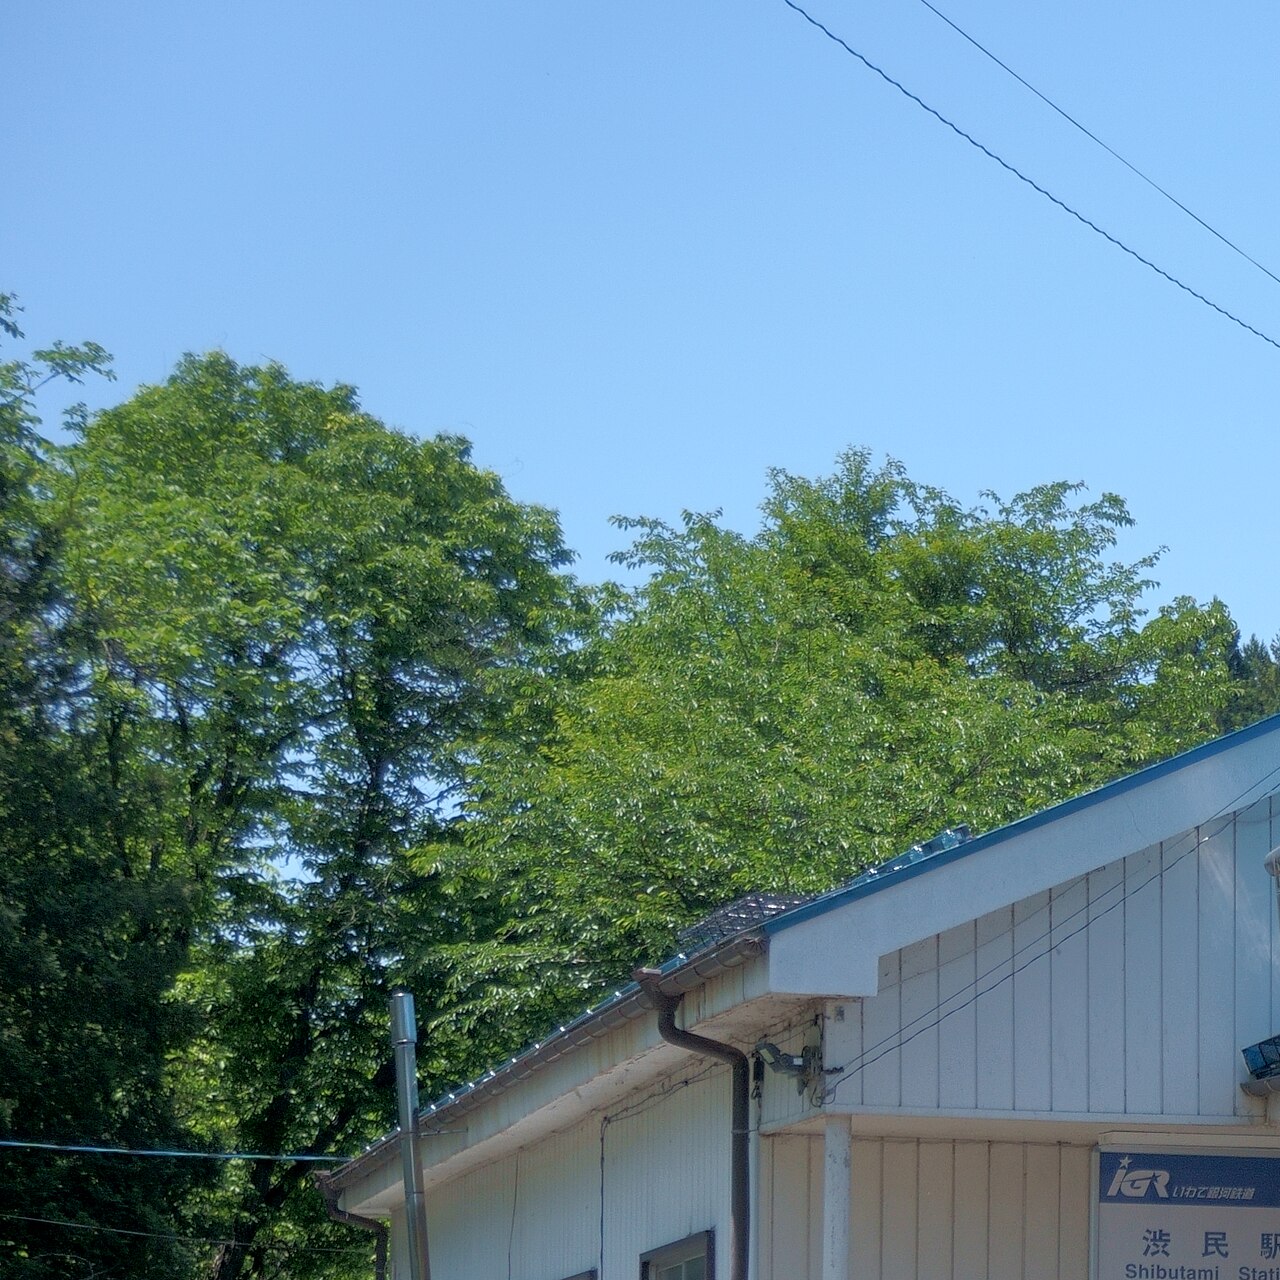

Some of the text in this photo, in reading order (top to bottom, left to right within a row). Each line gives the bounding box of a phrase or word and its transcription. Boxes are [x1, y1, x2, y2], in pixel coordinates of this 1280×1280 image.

[1172, 1186, 1255, 1200] いわて銀河鉄道
[1125, 1263, 1219, 1280] Shibutami
